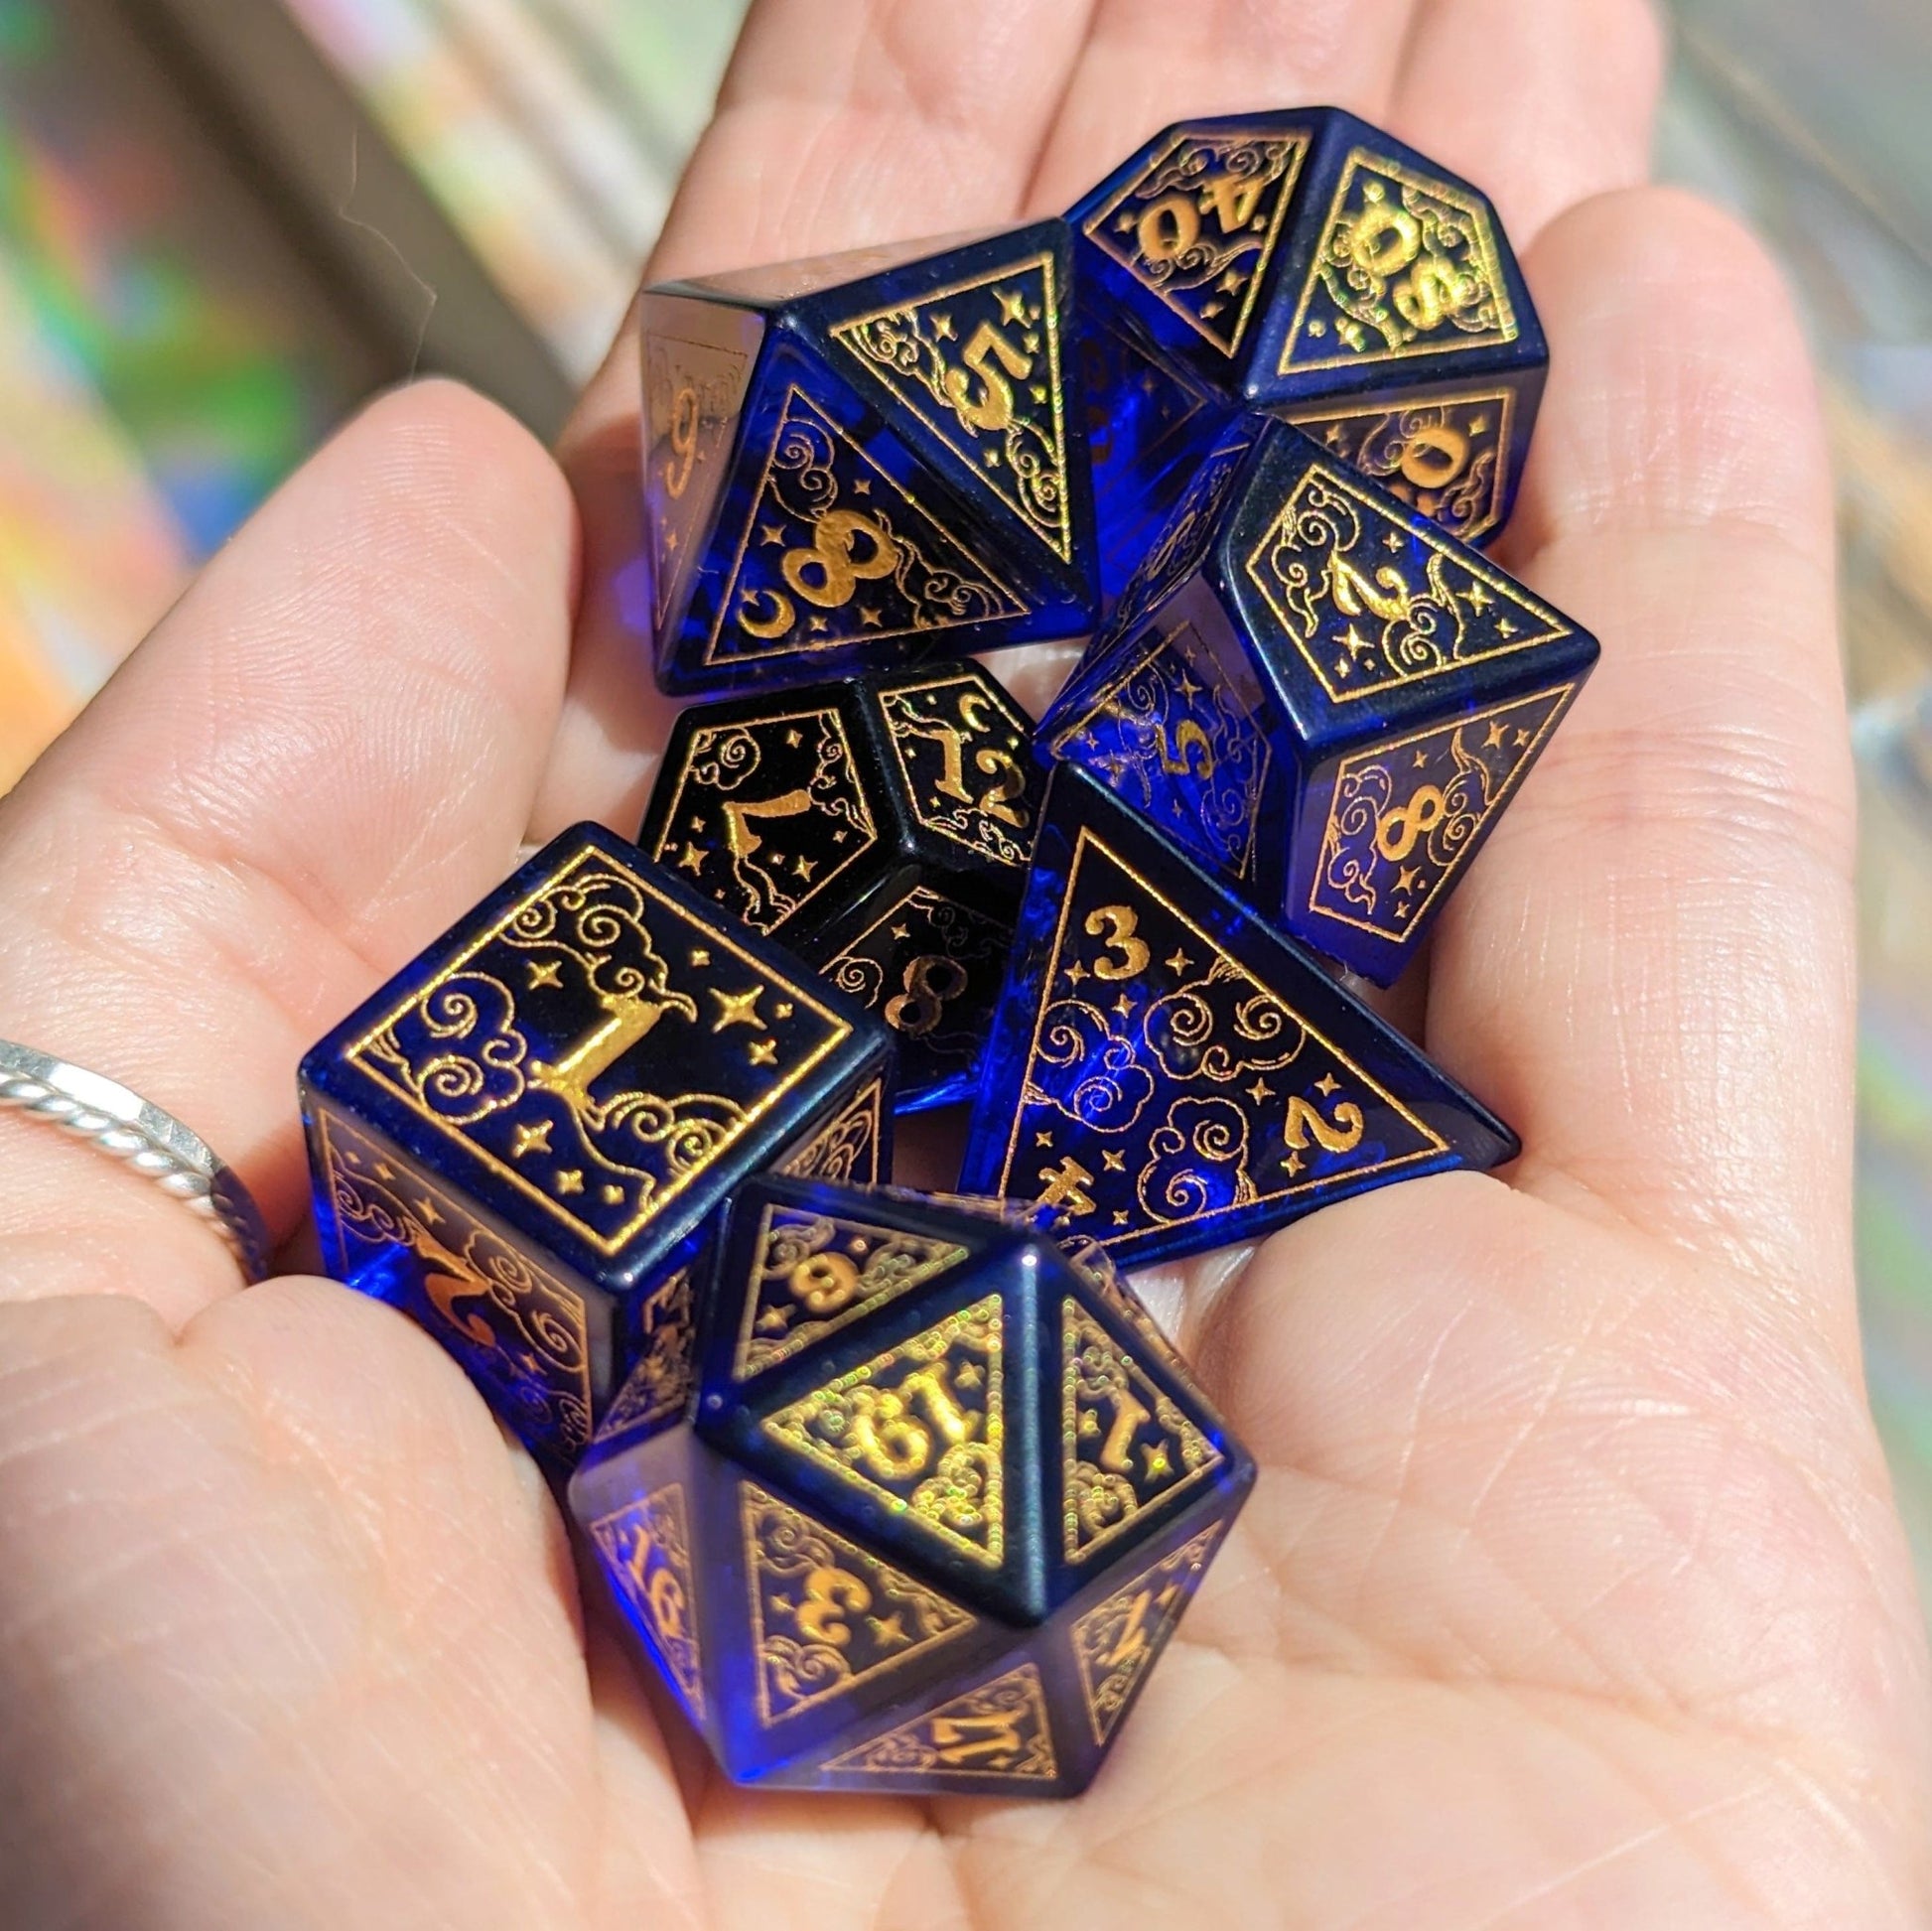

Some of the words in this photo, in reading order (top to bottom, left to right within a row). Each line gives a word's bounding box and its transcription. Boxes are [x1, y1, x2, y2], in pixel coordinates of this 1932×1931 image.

[1139, 174, 1265, 260] 40
[946, 321, 1034, 430] 5
[781, 509, 896, 608] 8
[1331, 550, 1410, 621] 2
[933, 731, 1030, 828] 12
[1154, 719, 1212, 779] 5
[721, 788, 812, 858] 7
[1378, 784, 1444, 861] 8
[1084, 905, 1151, 980] 3
[884, 954, 969, 1034] 8
[529, 993, 663, 1108] 1
[1284, 1094, 1364, 1154] 2
[1036, 1156, 1097, 1216] 4
[796, 1567, 870, 1647] 3
